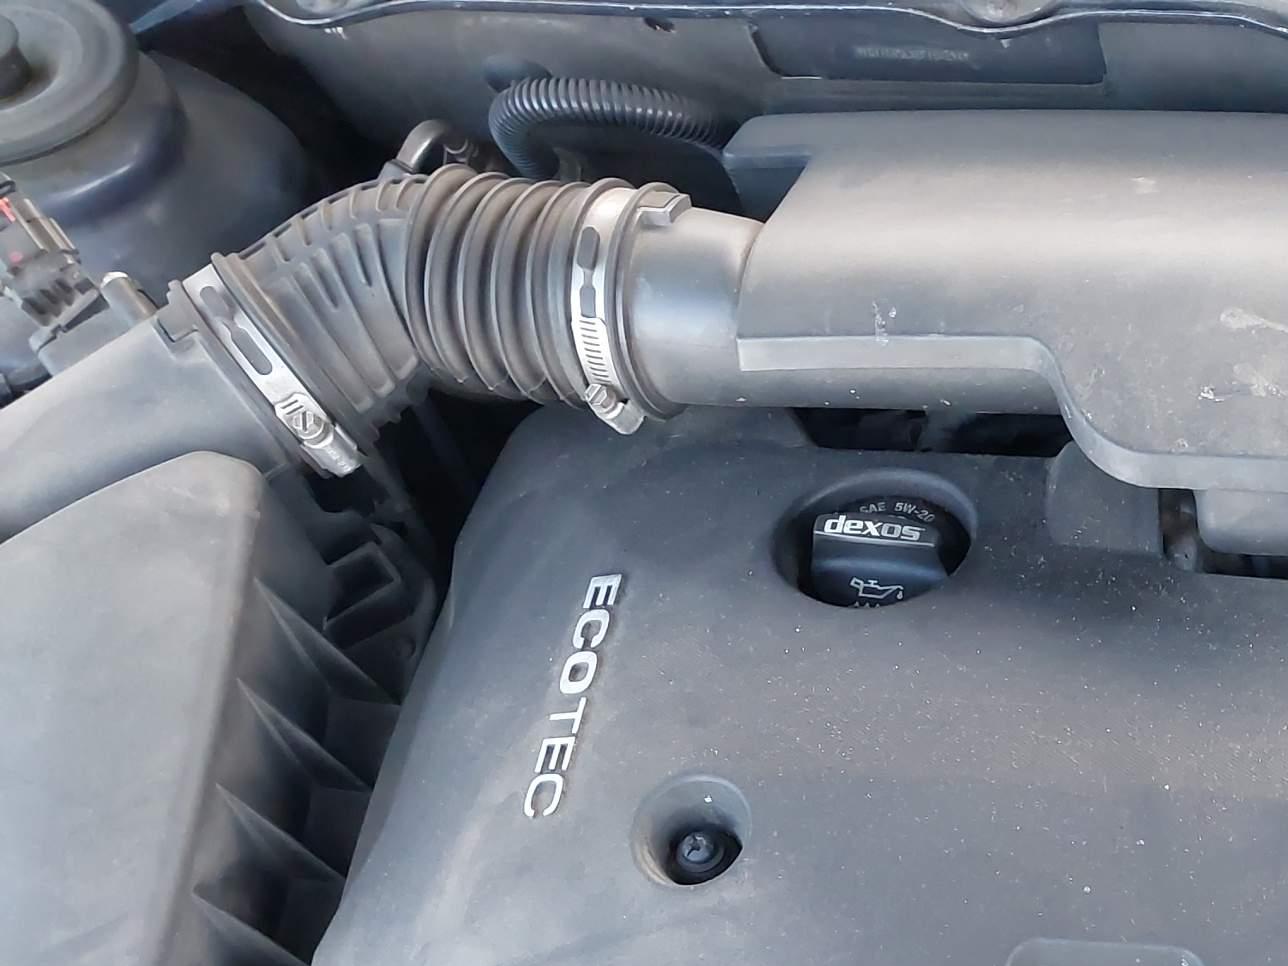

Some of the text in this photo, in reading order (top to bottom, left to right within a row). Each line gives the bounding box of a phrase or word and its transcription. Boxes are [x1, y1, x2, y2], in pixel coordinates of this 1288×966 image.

[859, 502, 935, 522] SAE 5W-20
[824, 515, 925, 541] dexos
[524, 574, 622, 818] ECOTEC
